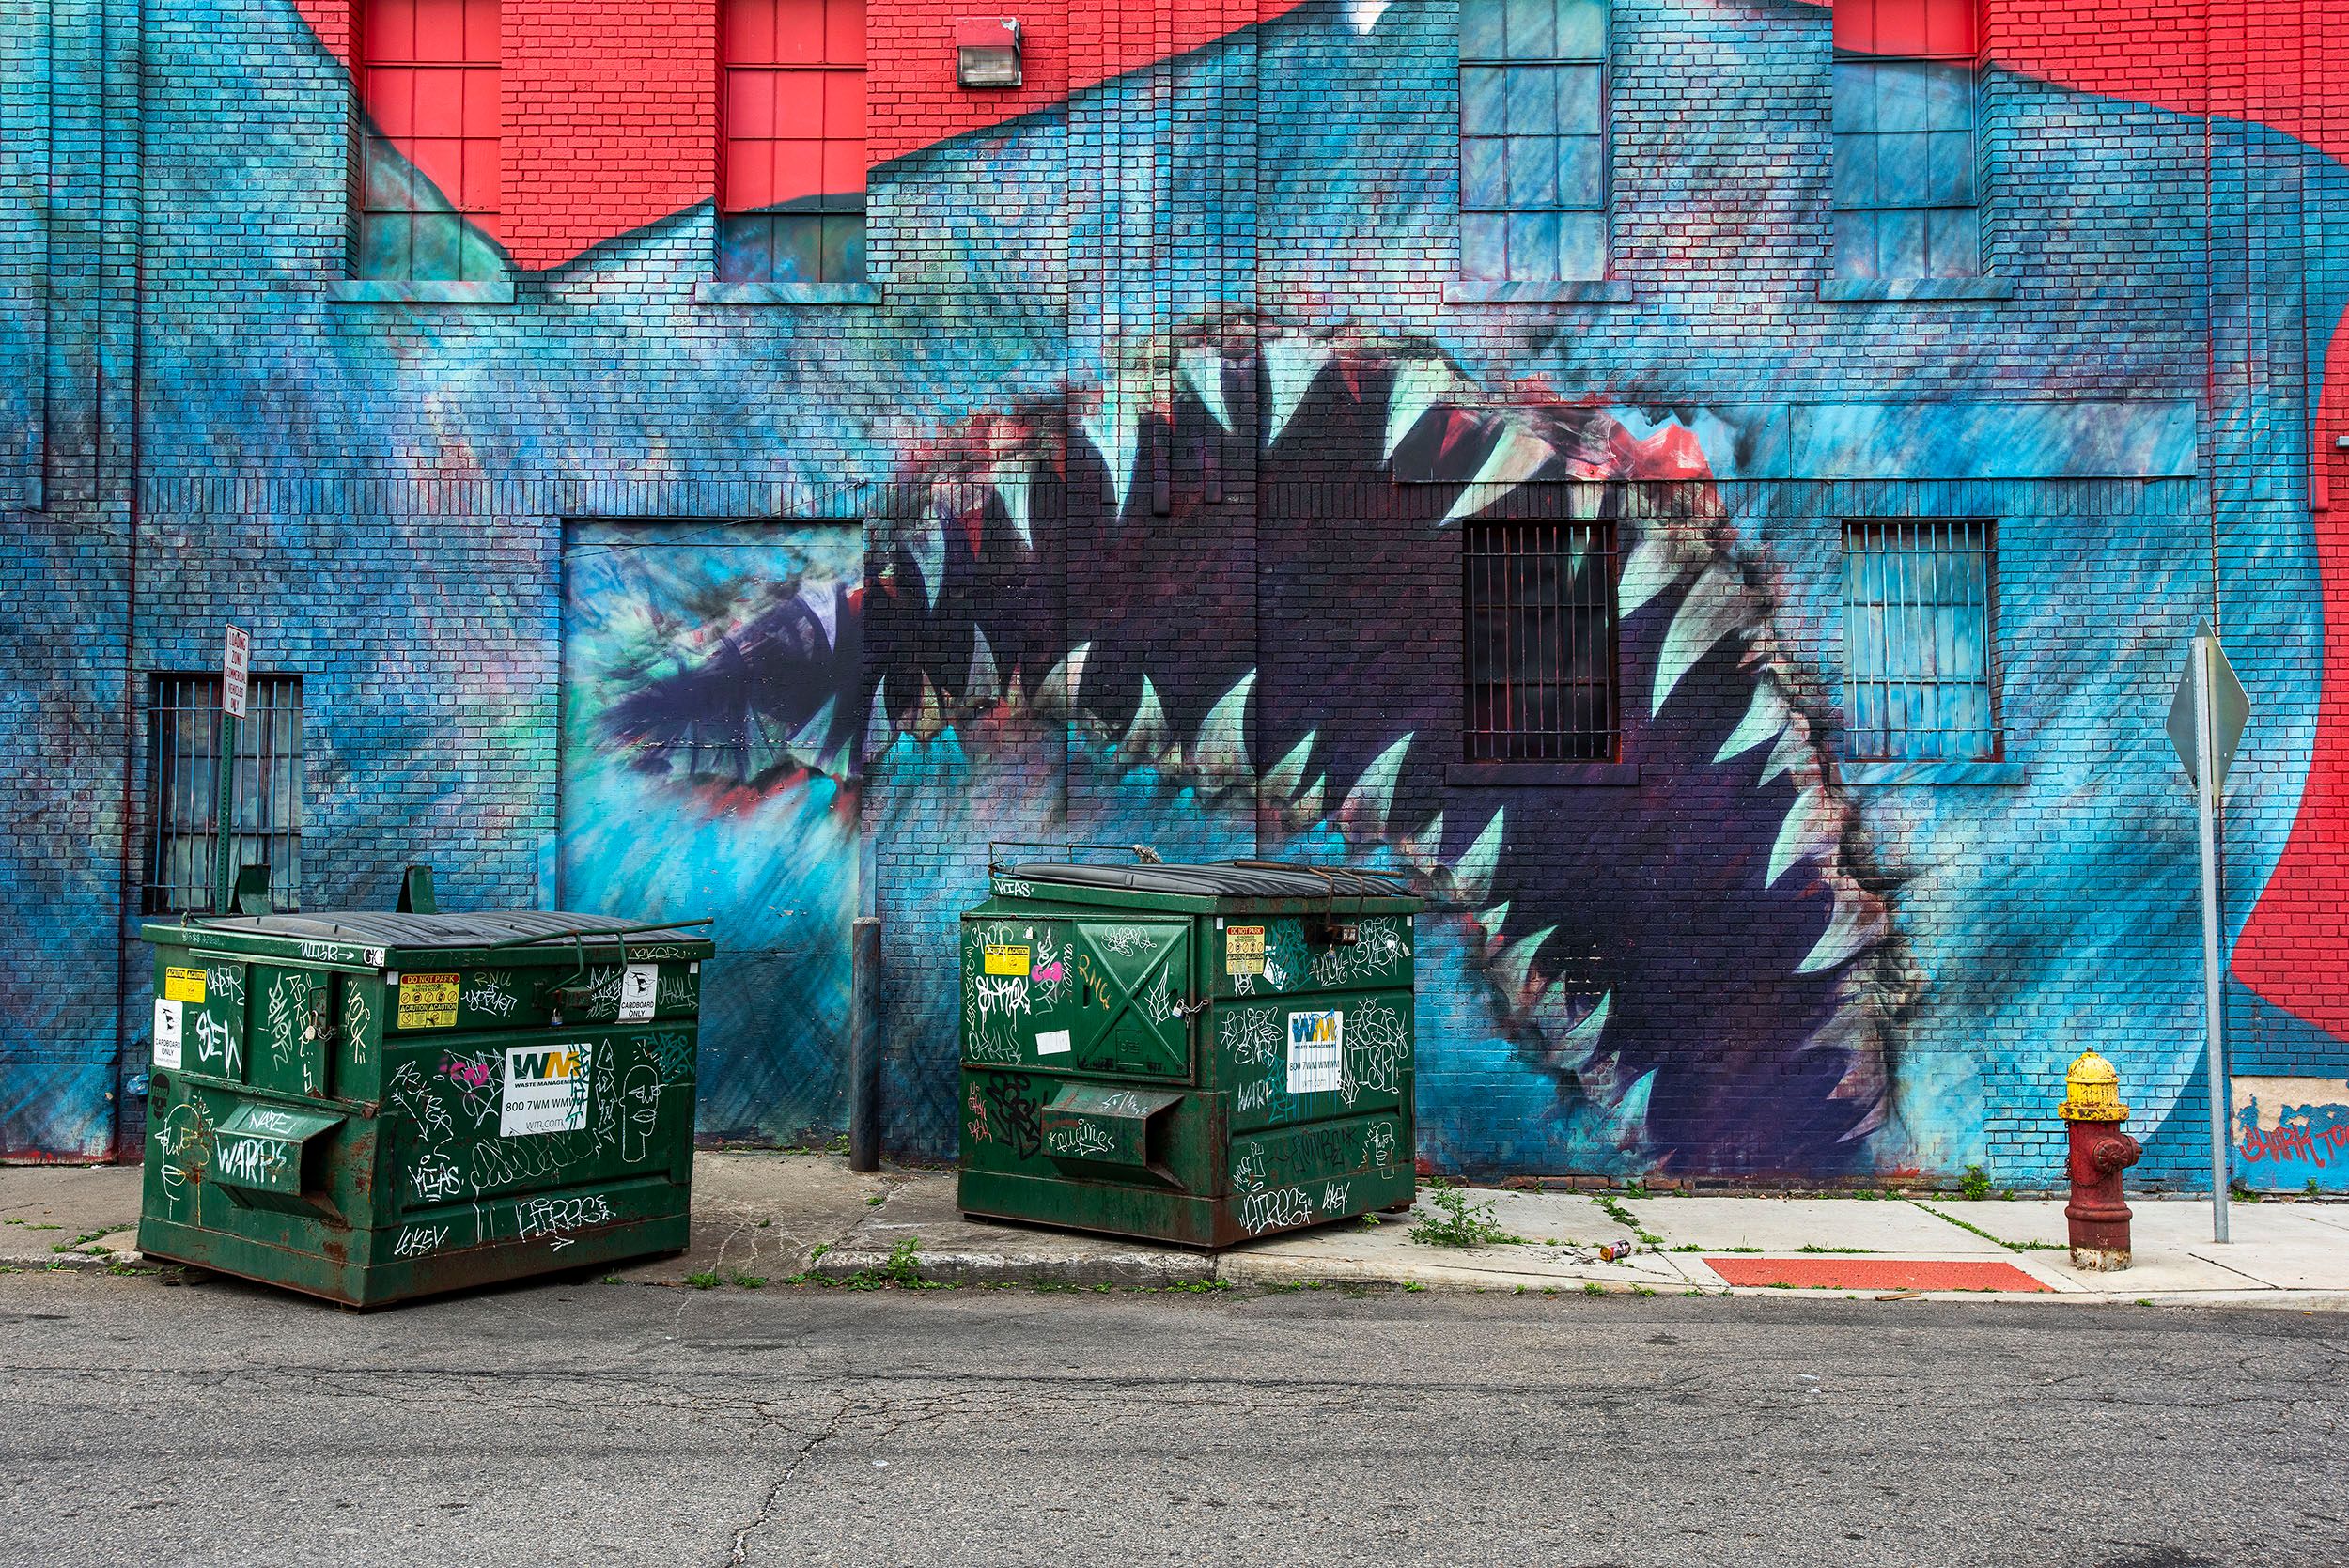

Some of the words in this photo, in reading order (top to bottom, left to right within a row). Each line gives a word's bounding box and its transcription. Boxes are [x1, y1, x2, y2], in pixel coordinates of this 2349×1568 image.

[231, 650, 242, 666] ZONE
[621, 1001, 654, 1009] CARDBOARD
[155, 1037, 181, 1049] CARDBOARD
[162, 1048, 175, 1057] ONLY
[512, 1051, 582, 1080] WM
[506, 1100, 524, 1112] 800
[527, 1099, 551, 1110] 7WM
[526, 1118, 564, 1129] wm.com
